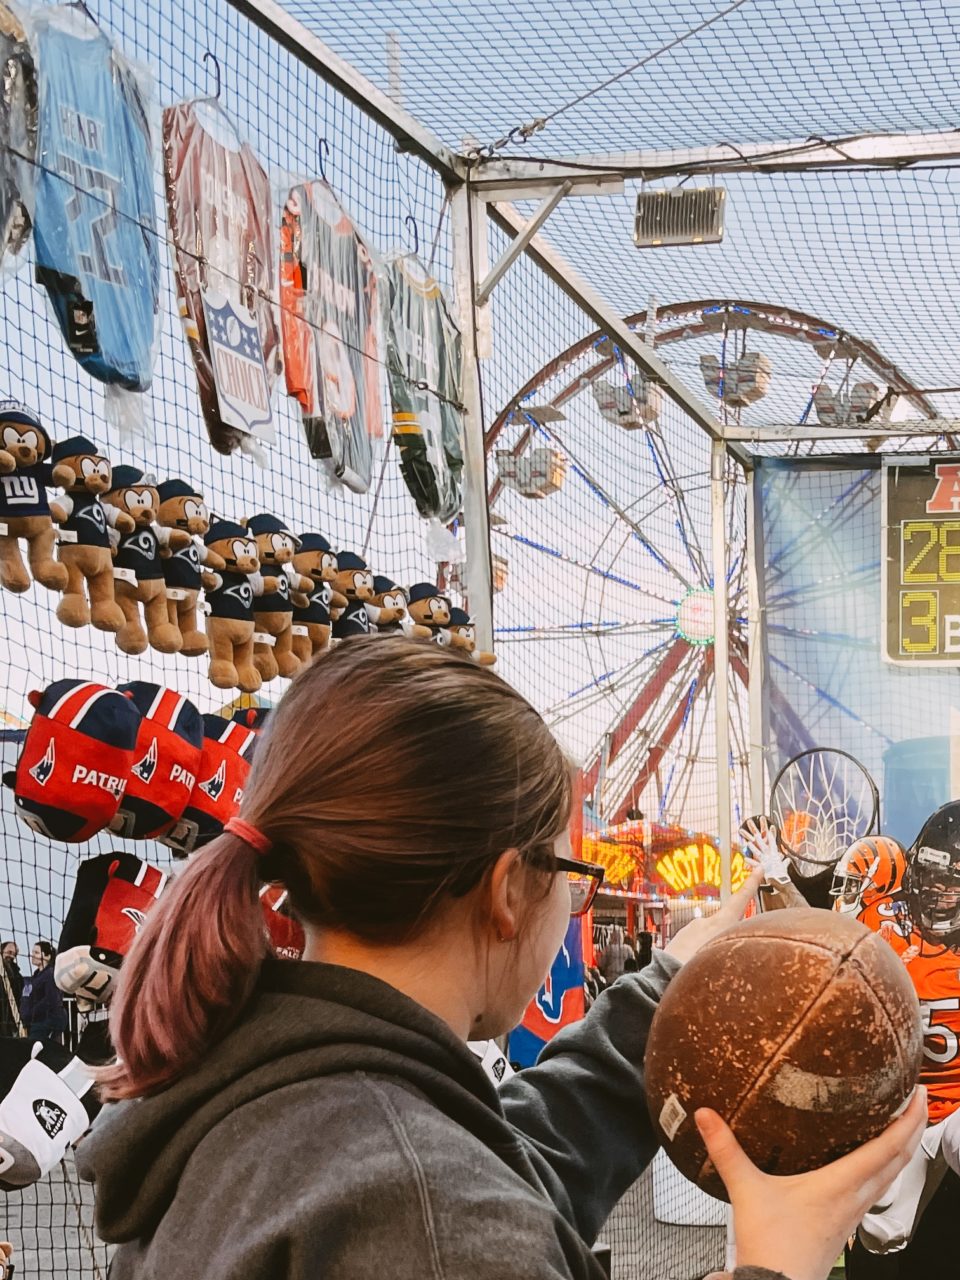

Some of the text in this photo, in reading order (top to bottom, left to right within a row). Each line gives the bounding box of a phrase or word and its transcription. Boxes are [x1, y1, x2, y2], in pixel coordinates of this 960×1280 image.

[219, 348, 268, 413] CHOICE
[902, 592, 937, 652] 3
[656, 843, 699, 891] HOT
